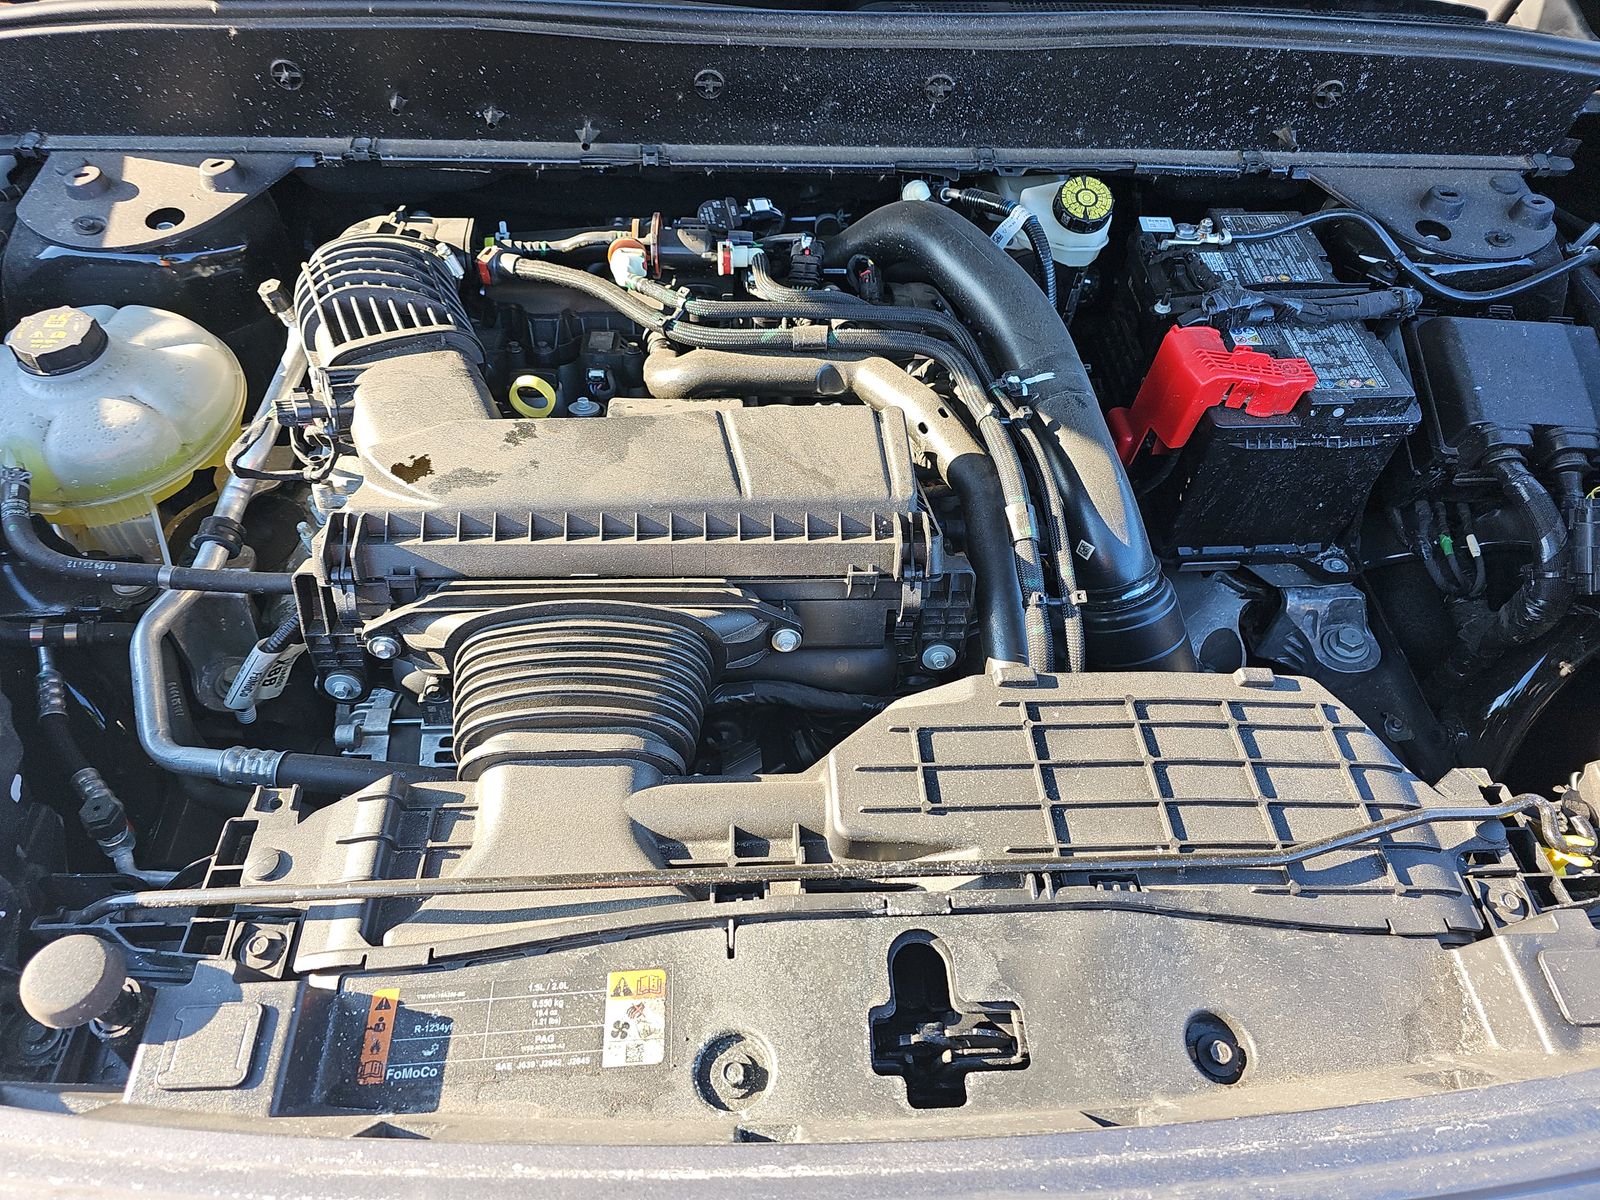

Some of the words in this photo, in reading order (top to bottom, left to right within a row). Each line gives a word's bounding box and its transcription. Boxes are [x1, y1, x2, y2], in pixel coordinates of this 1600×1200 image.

[262, 658, 290, 687] XBB
[551, 981, 569, 991] 2.0L
[553, 998, 564, 1009] kg
[414, 1020, 454, 1034] R-1234yf
[534, 1034, 555, 1043] PAG
[495, 1062, 513, 1071] SAE
[385, 1065, 438, 1081] FoMoCo
